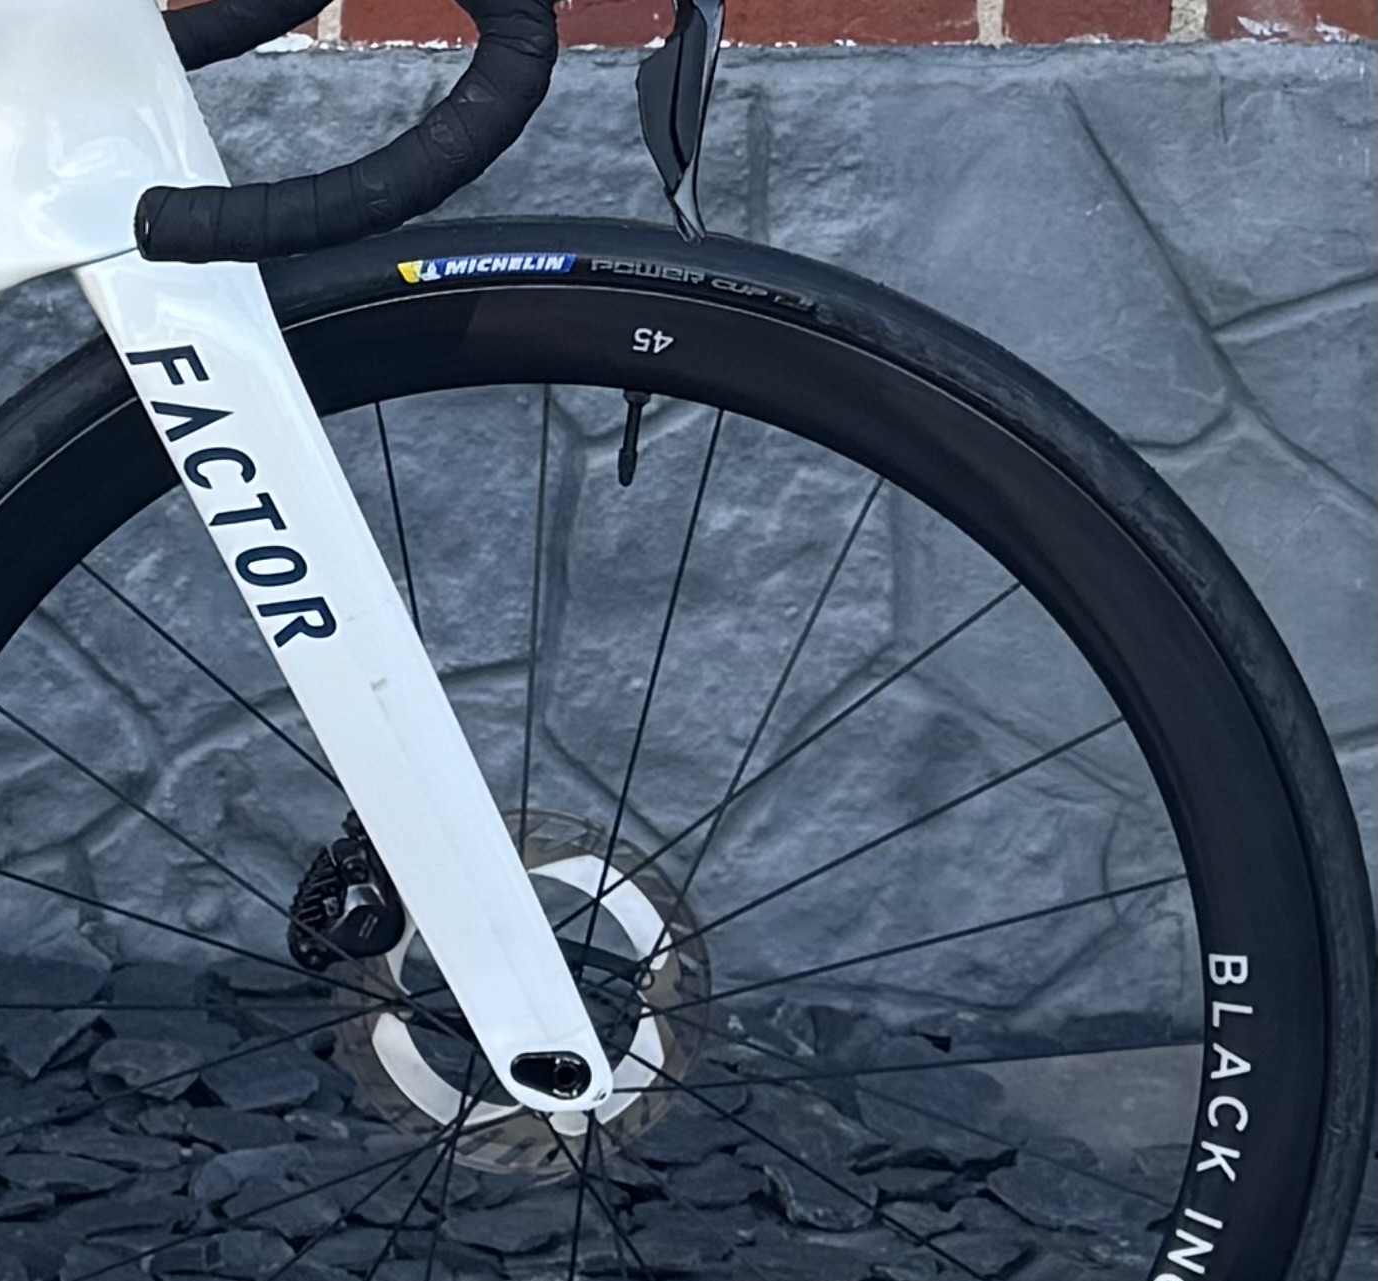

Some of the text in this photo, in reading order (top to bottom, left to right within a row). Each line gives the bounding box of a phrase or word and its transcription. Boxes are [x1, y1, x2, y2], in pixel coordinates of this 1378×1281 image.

[444, 255, 769, 298] MICHELIN POWER CUP
[632, 327, 675, 355] 45
[126, 344, 338, 649] FACTOR
[1196, 952, 1255, 1184] BLACK
